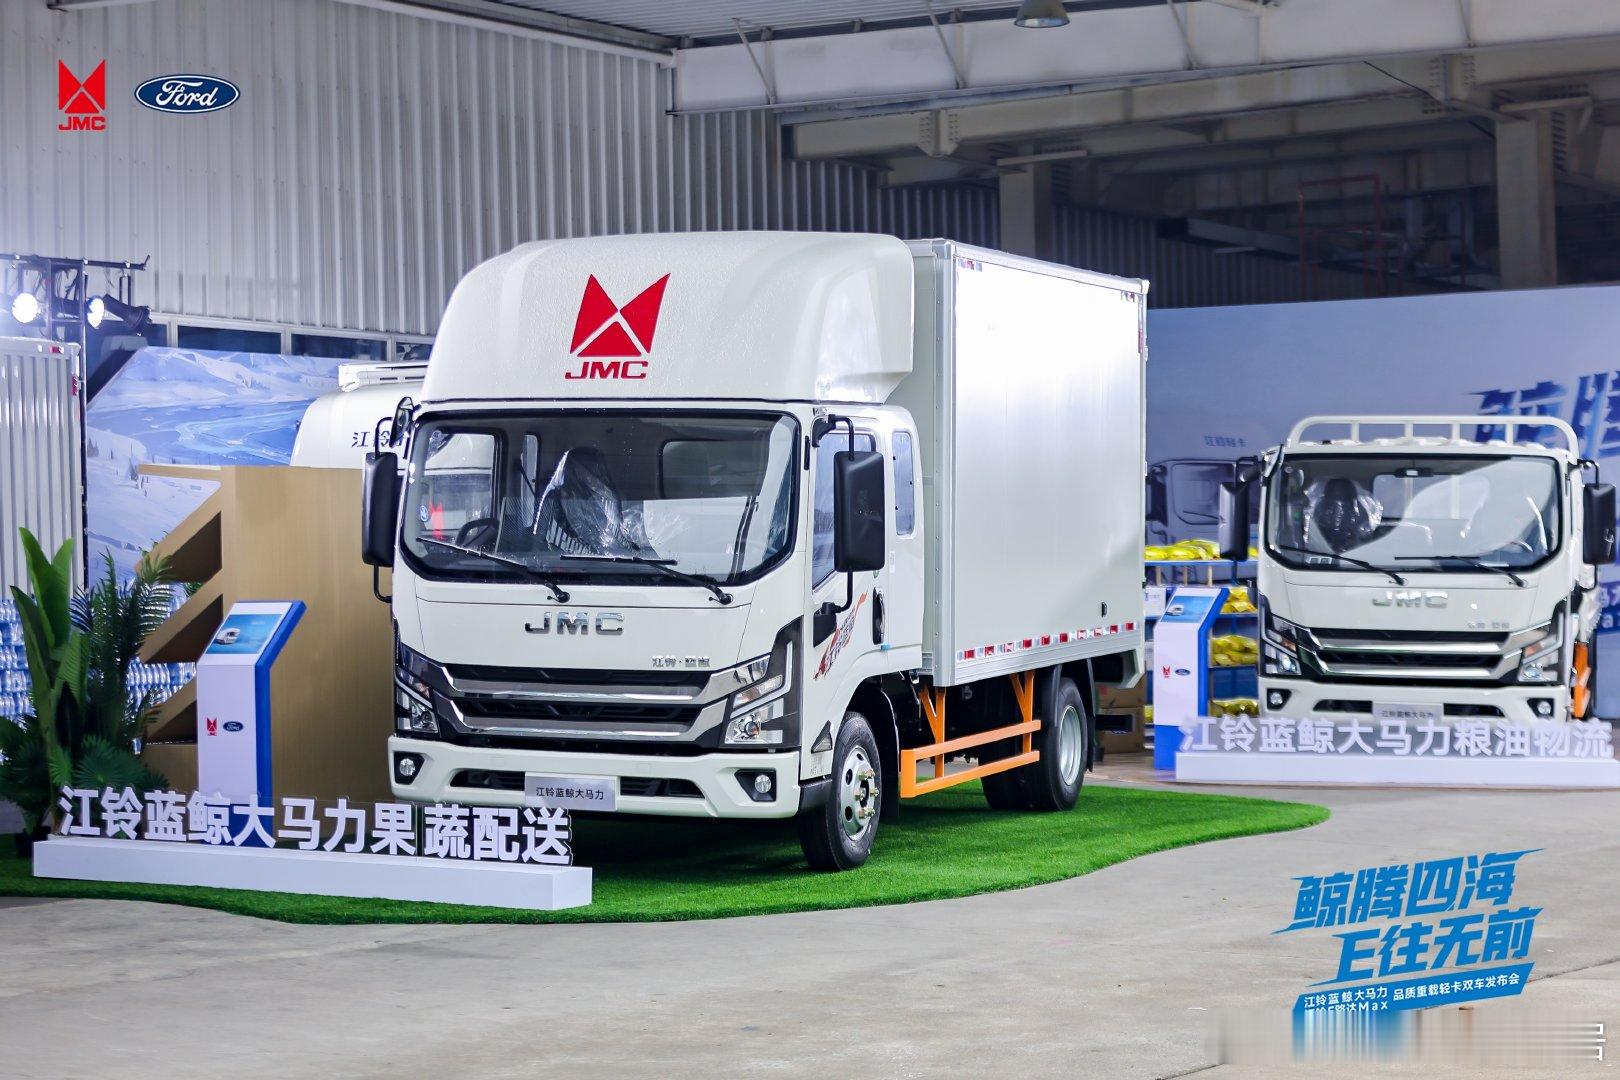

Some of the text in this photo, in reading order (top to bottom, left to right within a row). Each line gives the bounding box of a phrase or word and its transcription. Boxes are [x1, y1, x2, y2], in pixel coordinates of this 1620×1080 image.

[564, 360, 649, 379] JMC
[1372, 591, 1449, 608] JMC
[524, 611, 625, 635] JMC
[1180, 716, 1614, 759] 江铃蓝鲸大马力粮油物流
[536, 787, 604, 800] 江铃蓝鲸大马力
[60, 786, 572, 865] 江铃蓝鲸大马力果蔬配送
